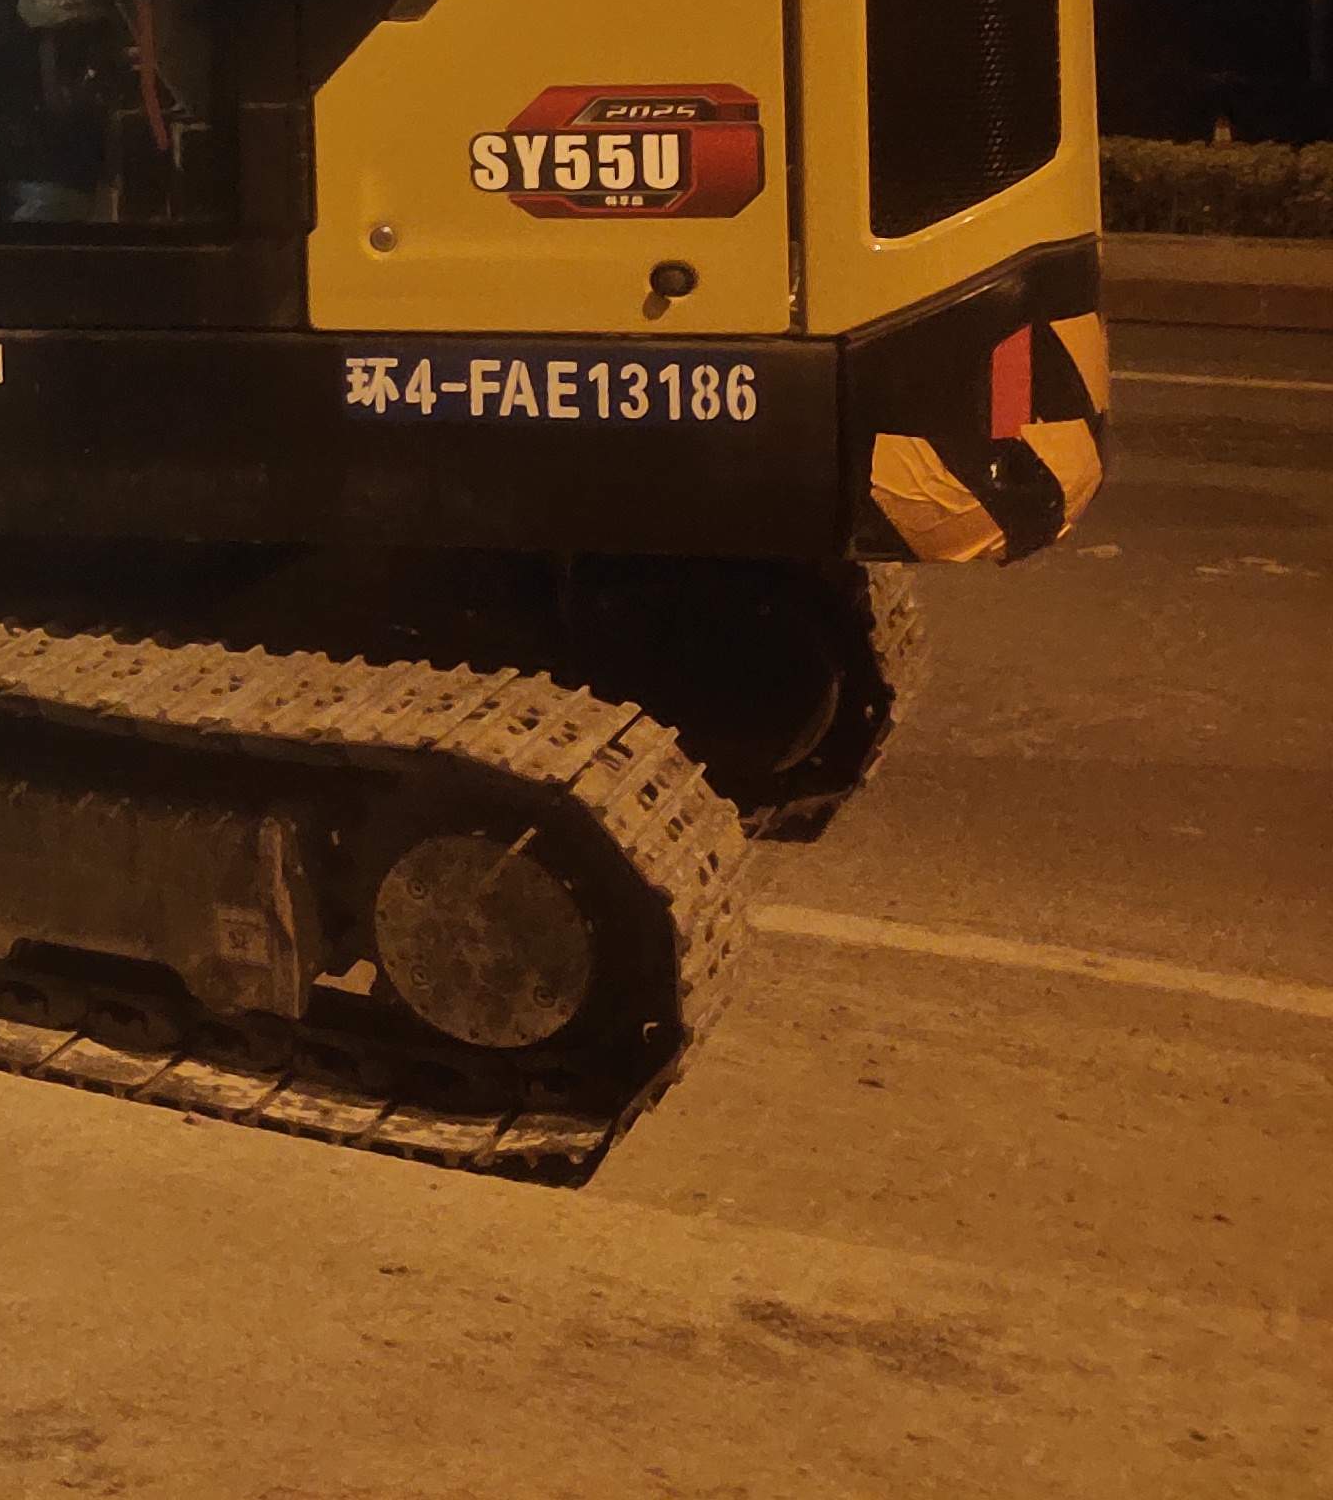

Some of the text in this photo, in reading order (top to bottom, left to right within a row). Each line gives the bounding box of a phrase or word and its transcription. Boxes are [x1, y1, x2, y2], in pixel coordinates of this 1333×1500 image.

[605, 103, 697, 119] 2025
[471, 133, 680, 190] SY55U
[345, 357, 757, 421] 环4-FAE13186
